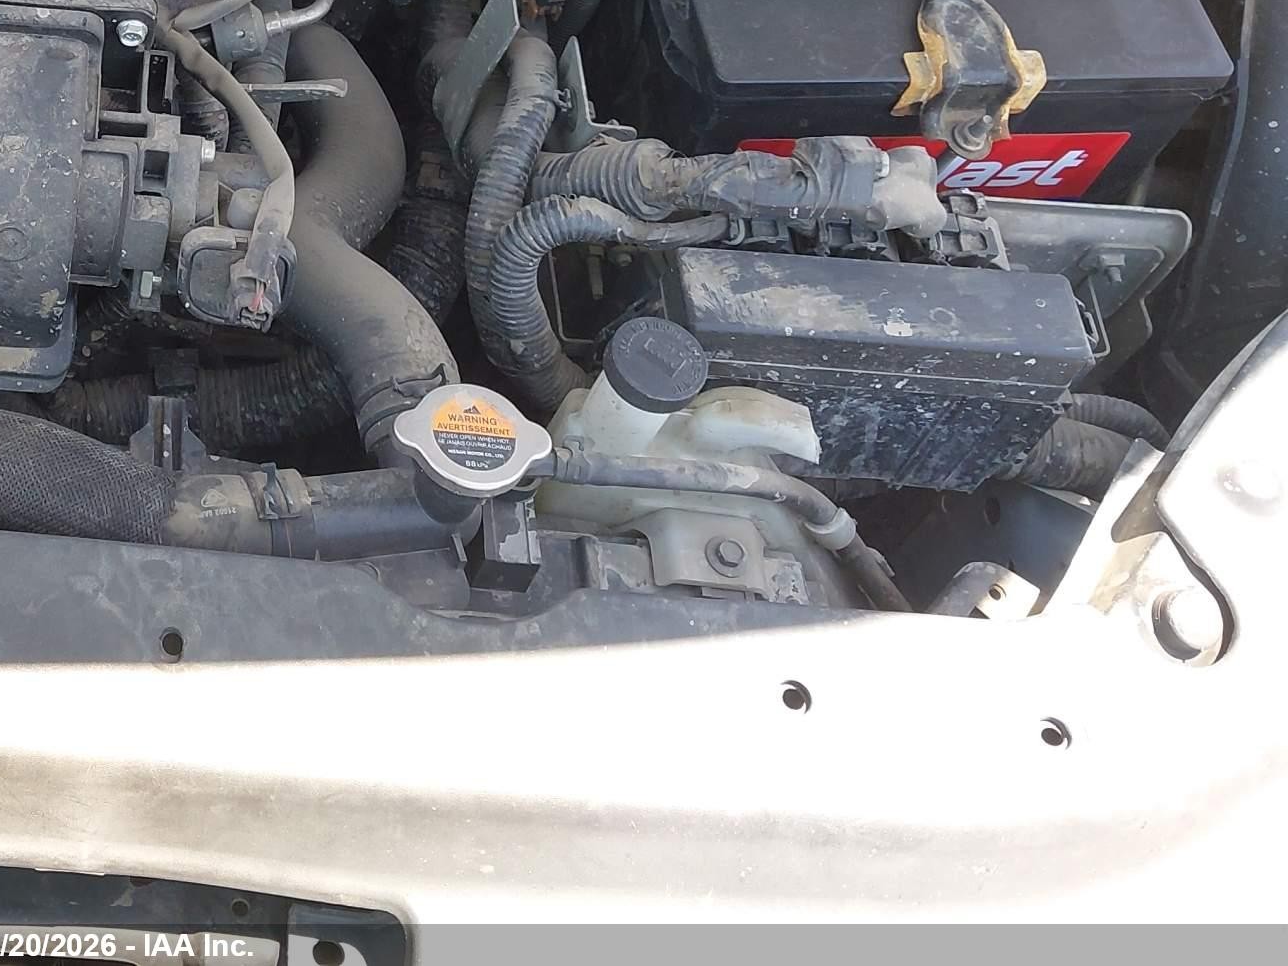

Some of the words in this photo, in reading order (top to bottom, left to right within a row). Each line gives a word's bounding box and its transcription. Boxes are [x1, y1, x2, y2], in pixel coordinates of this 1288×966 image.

[447, 413, 498, 426] WARNING
[437, 422, 511, 436] AVERTISSEMENT
[439, 432, 458, 440] NEVER
[477, 435, 497, 443] WHEN
